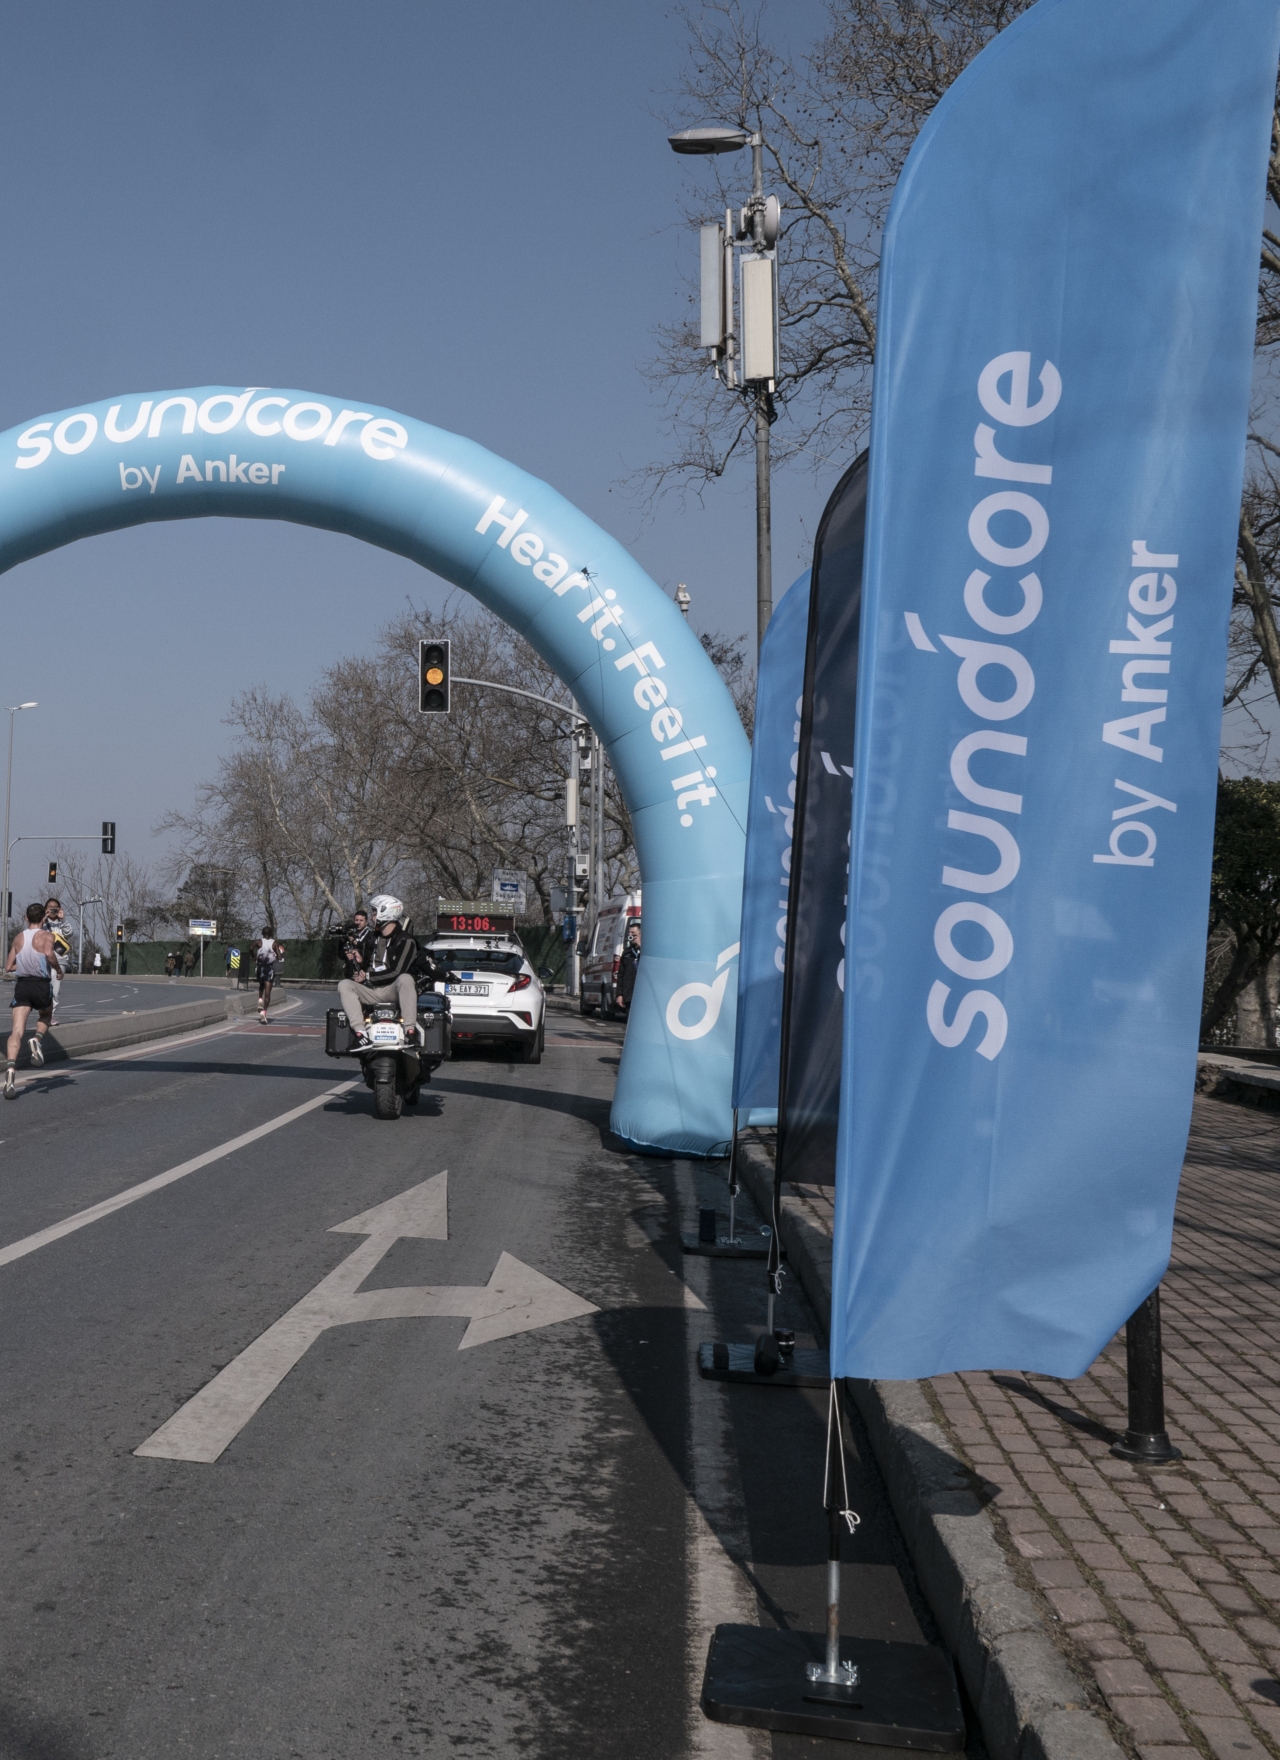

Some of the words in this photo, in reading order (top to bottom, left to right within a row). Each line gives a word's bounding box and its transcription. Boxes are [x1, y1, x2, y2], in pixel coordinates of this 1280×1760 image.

[14, 387, 409, 470] soundcore
[119, 462, 161, 494] by
[175, 453, 286, 487] Anker
[475, 494, 591, 598] Hear
[576, 589, 625, 653] it.
[614, 641, 710, 763] Feel
[670, 766, 718, 828] it.
[1102, 539, 1181, 763] Anker
[903, 350, 1063, 1063] soundcore
[1093, 778, 1178, 868] by
[459, 985, 472, 993] EAY
[474, 985, 486, 994] 371
